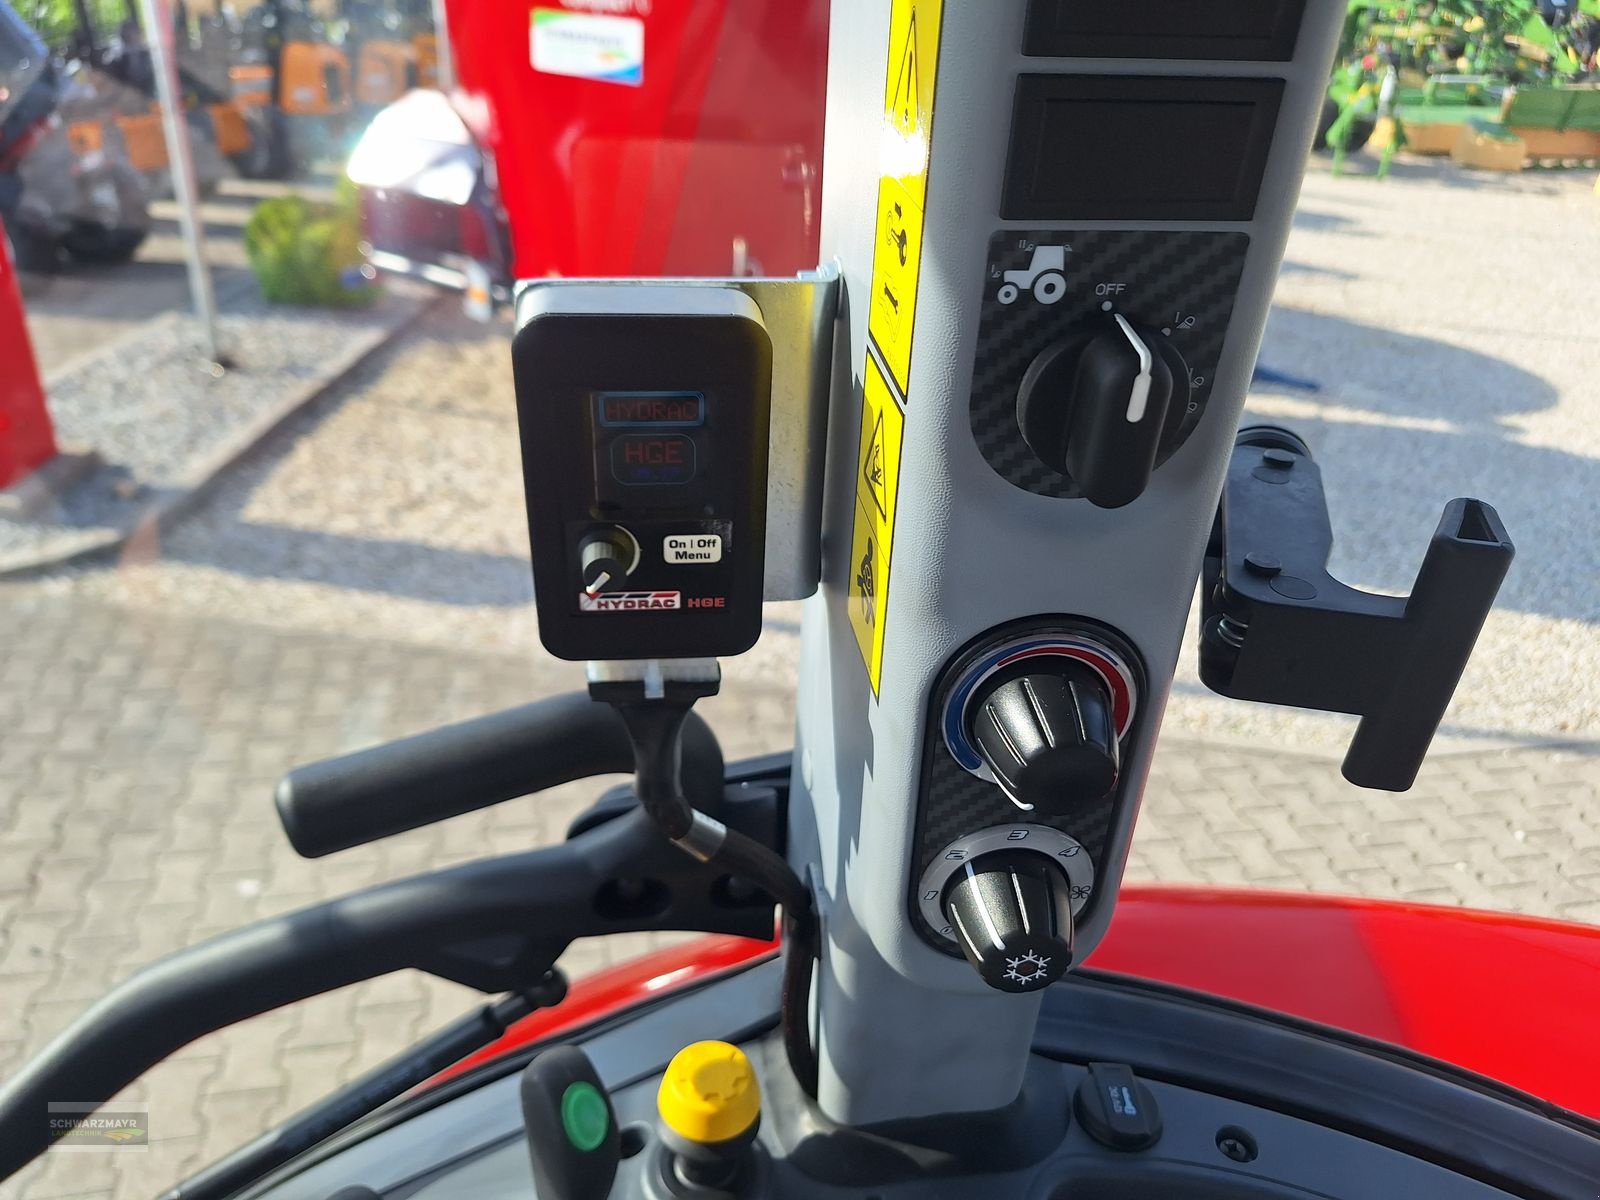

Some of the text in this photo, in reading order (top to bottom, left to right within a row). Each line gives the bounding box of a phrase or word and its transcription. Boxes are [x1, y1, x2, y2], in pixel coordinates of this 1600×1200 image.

[1096, 283, 1126, 296] OFF
[606, 400, 697, 420] HYDRAC
[624, 441, 684, 464] HGE
[669, 540, 686, 549] On
[697, 539, 716, 548] Off
[675, 551, 711, 560] Menu
[597, 598, 725, 609] HYDRAC HGE
[1007, 829, 1030, 841] 3
[945, 850, 968, 861] 2
[1058, 845, 1081, 858] 4
[924, 891, 938, 900] 1
